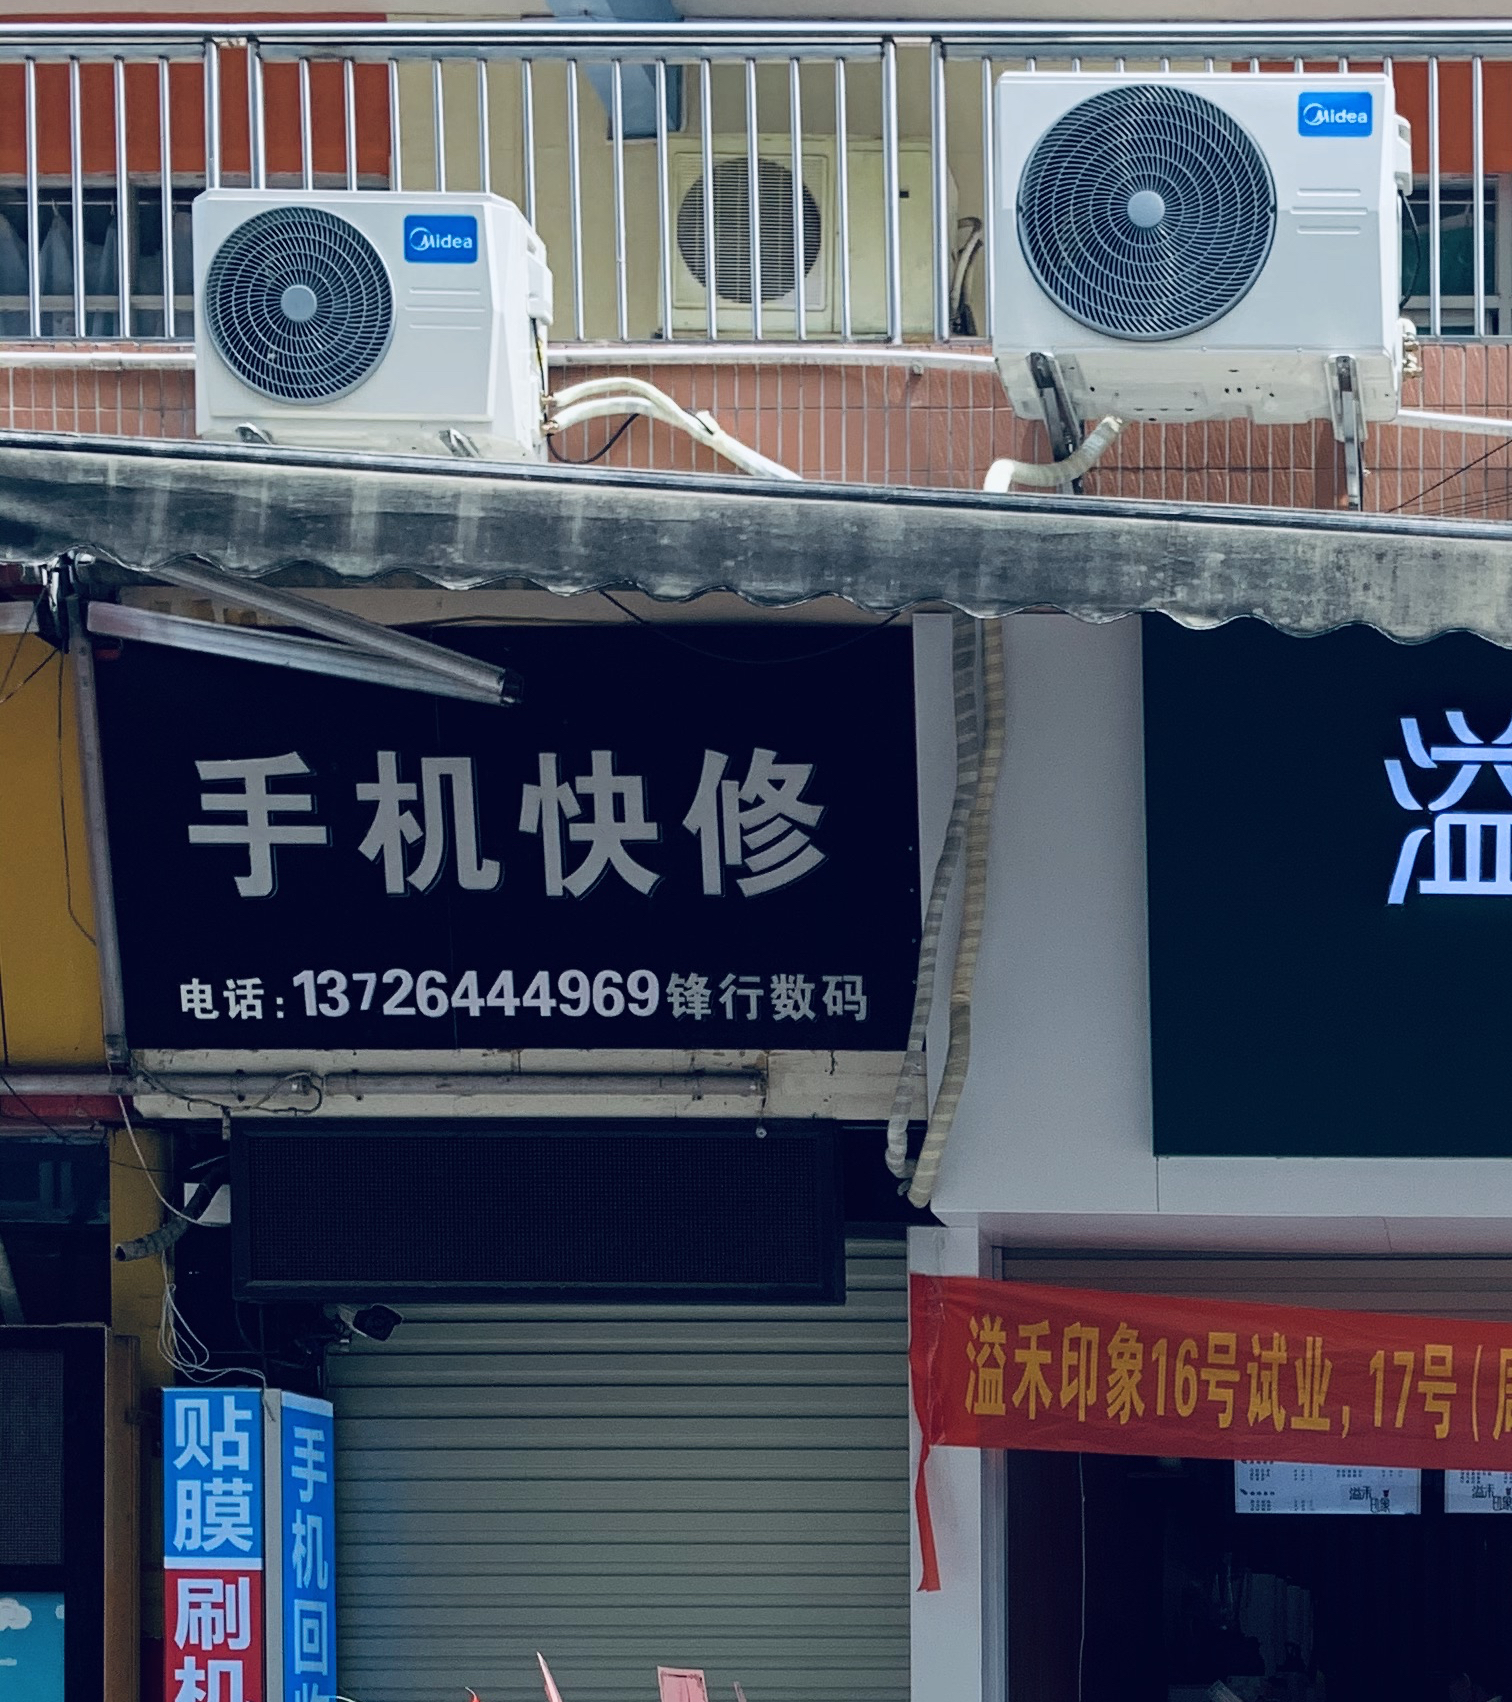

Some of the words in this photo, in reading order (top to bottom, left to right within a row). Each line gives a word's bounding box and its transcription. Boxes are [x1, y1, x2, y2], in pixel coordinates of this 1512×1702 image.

[1303, 103, 1368, 126] Midea
[409, 226, 473, 251] Midea
[187, 747, 828, 898] 手机快修
[172, 1395, 253, 1552] 贴膜
[291, 1425, 329, 1702] 手机回
